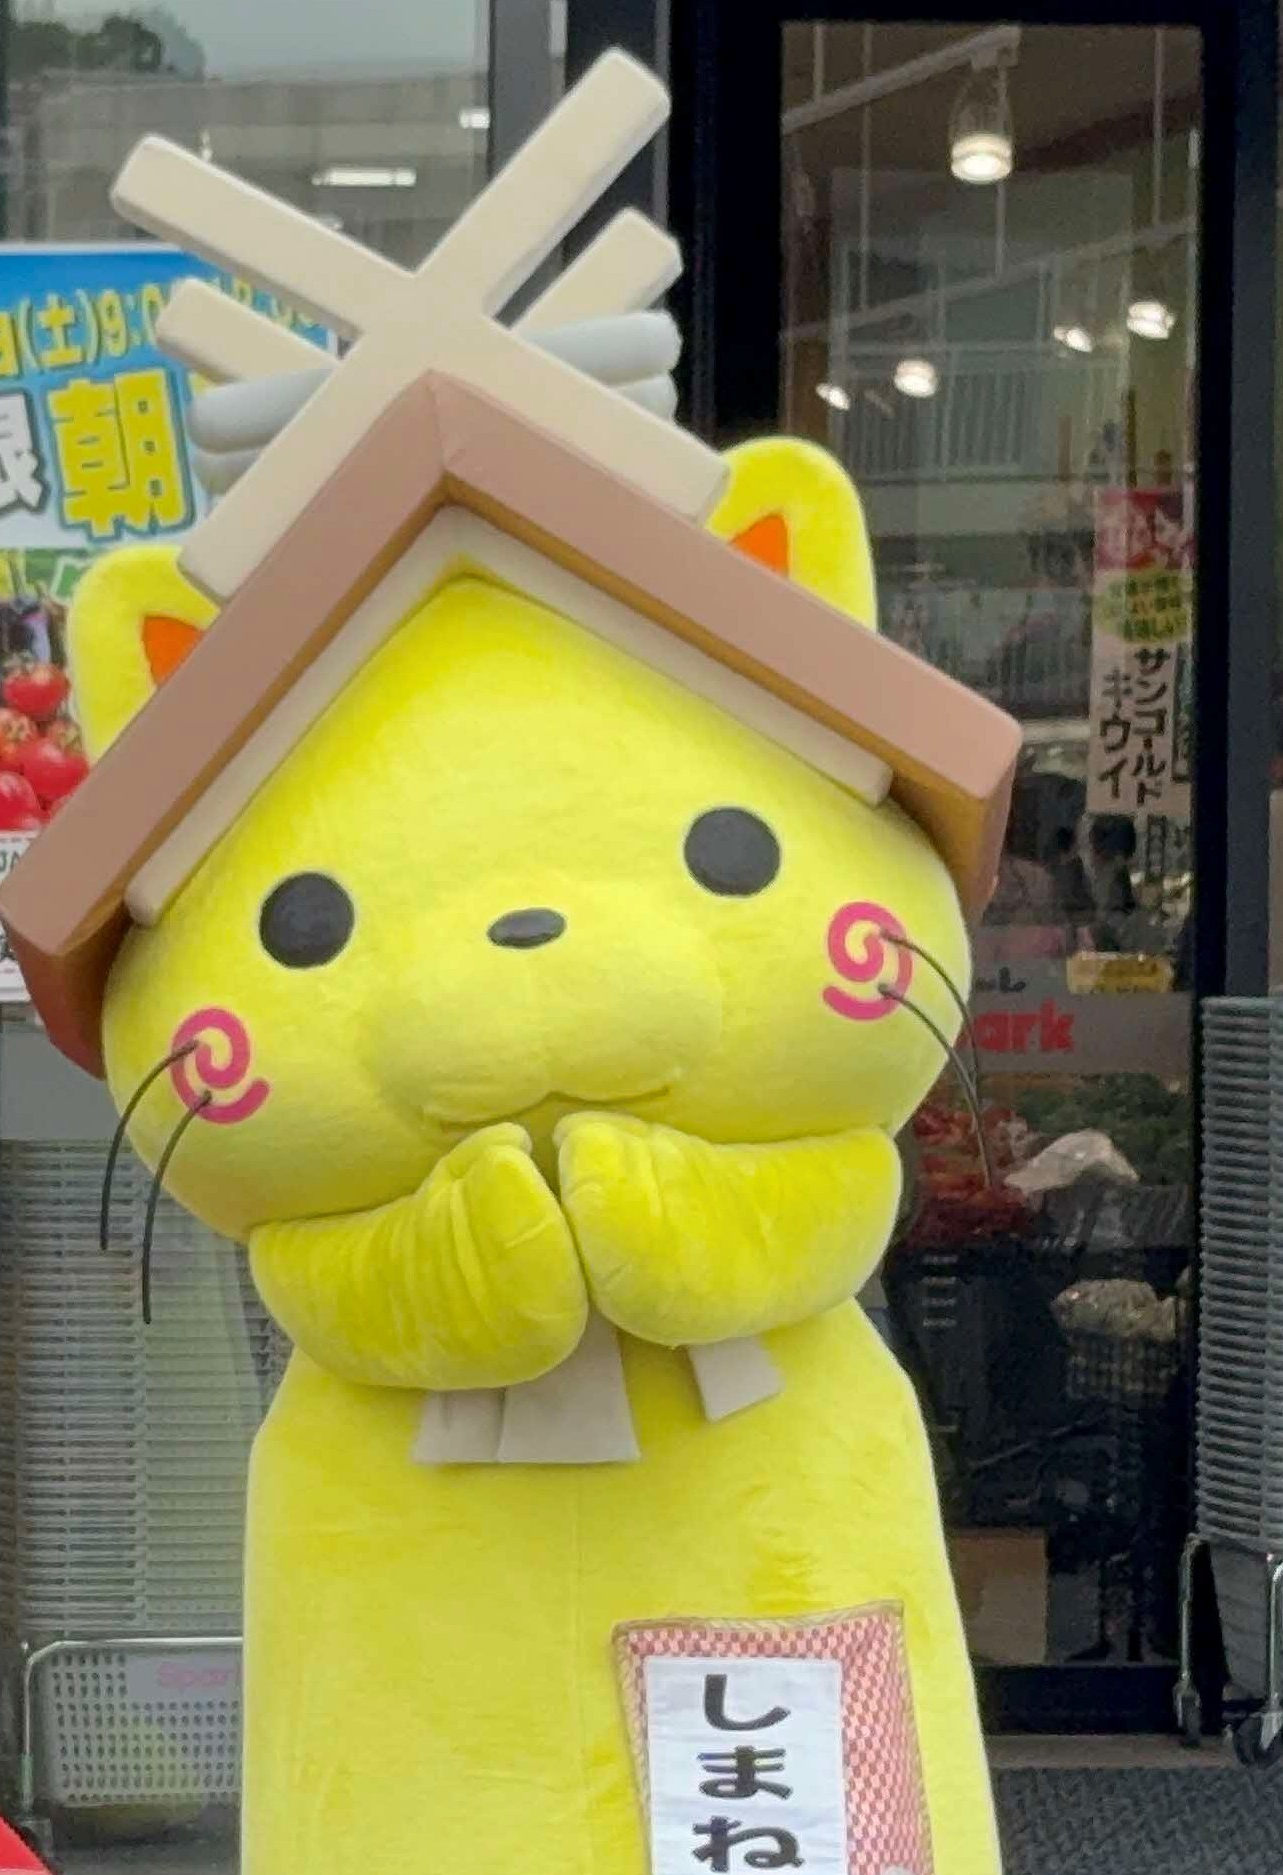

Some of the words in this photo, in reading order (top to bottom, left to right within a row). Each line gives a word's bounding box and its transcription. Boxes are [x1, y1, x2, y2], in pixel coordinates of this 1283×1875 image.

[958, 999, 1075, 1053] ark
[691, 1673, 805, 1873] しまね
